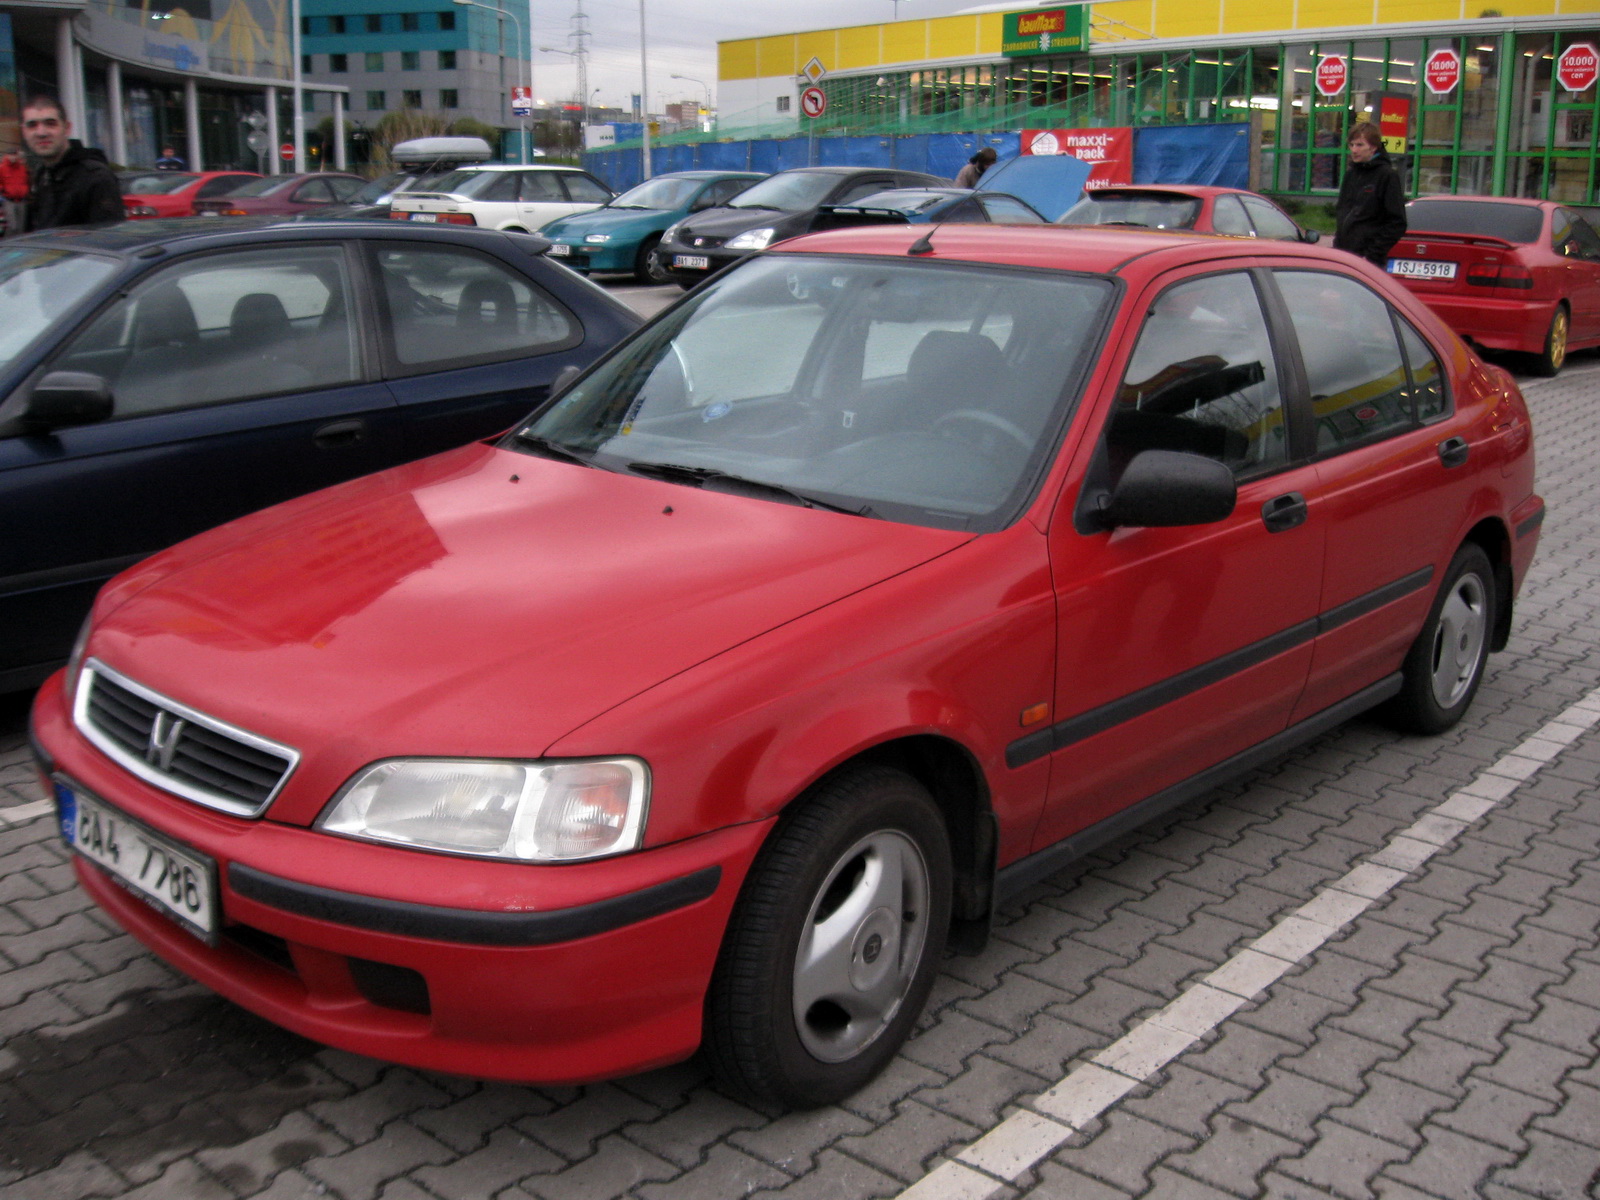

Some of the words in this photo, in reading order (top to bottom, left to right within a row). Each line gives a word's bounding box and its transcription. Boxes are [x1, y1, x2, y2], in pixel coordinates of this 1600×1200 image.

[1430, 61, 1456, 70] 10.000
[1564, 56, 1594, 66] 10.000
[1067, 133, 1114, 147] maxxi-
[1075, 146, 1105, 160] pack
[1397, 261, 1416, 273] 1SJ
[1423, 263, 1451, 276] 5918
[137, 834, 201, 914] 7786
